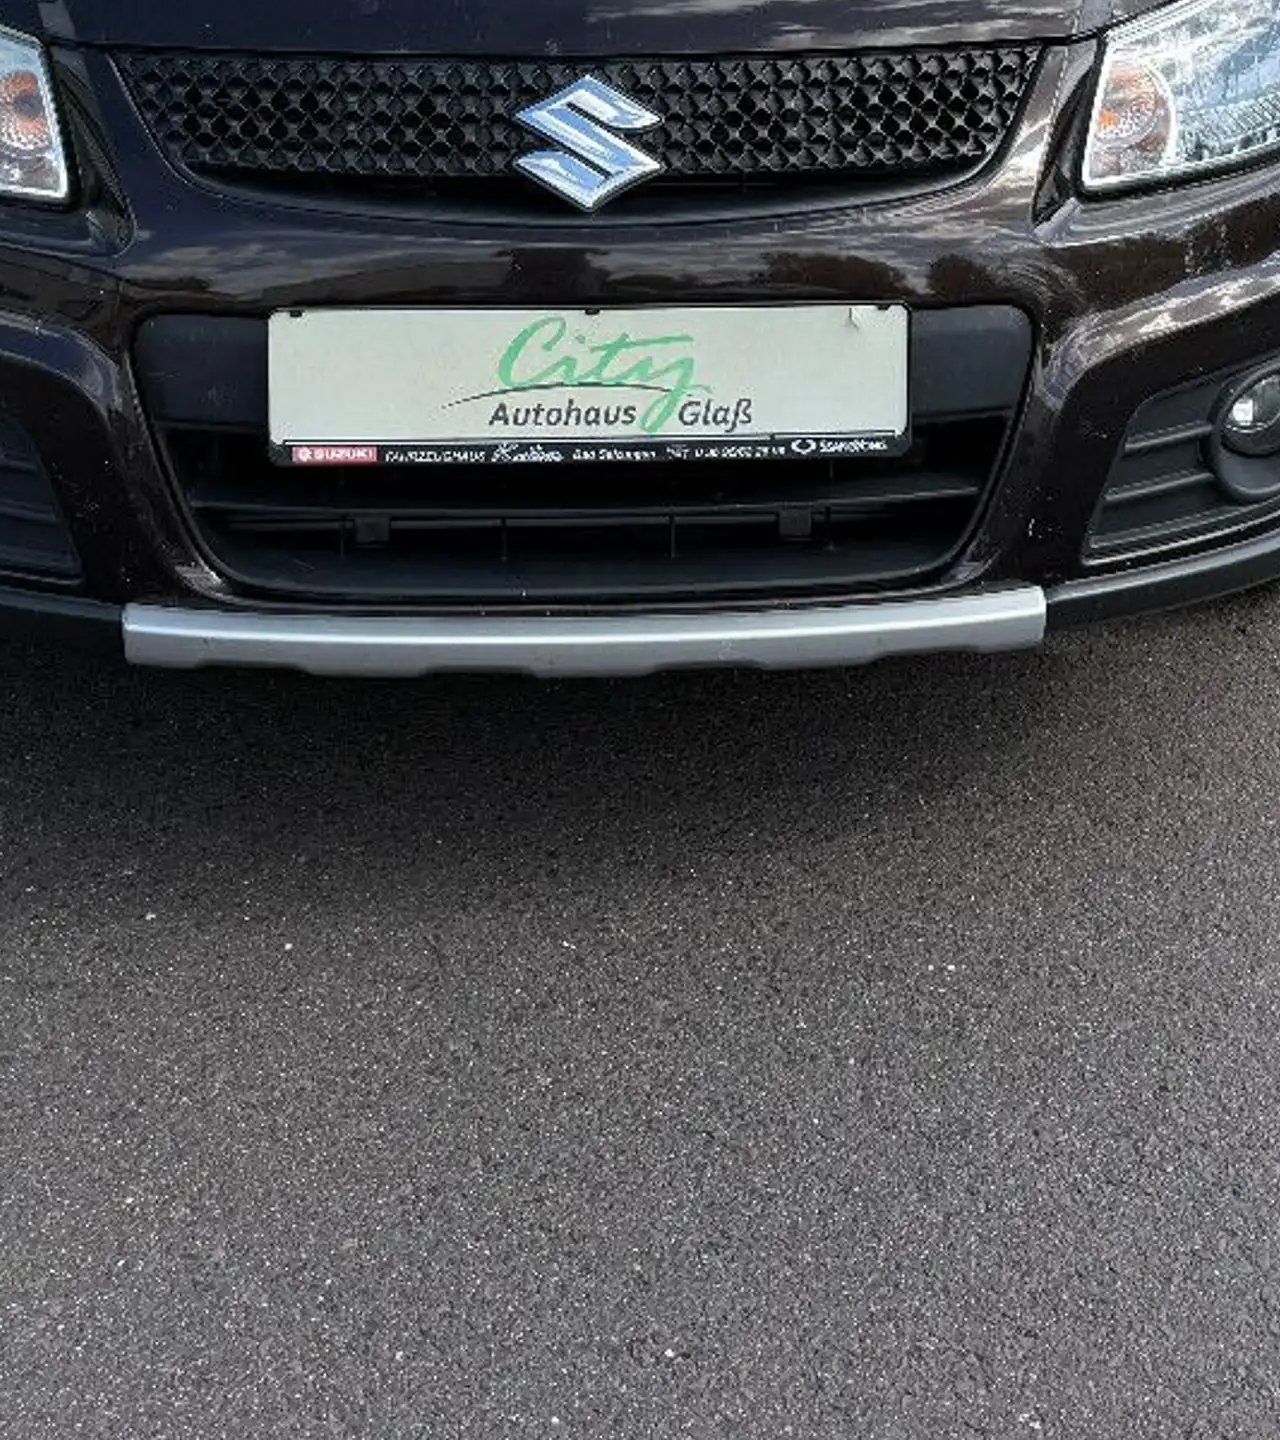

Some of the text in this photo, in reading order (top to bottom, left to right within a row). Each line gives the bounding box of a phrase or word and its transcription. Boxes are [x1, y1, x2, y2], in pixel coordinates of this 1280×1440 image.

[498, 316, 714, 435] City
[488, 397, 753, 433] Autohaus Glaß
